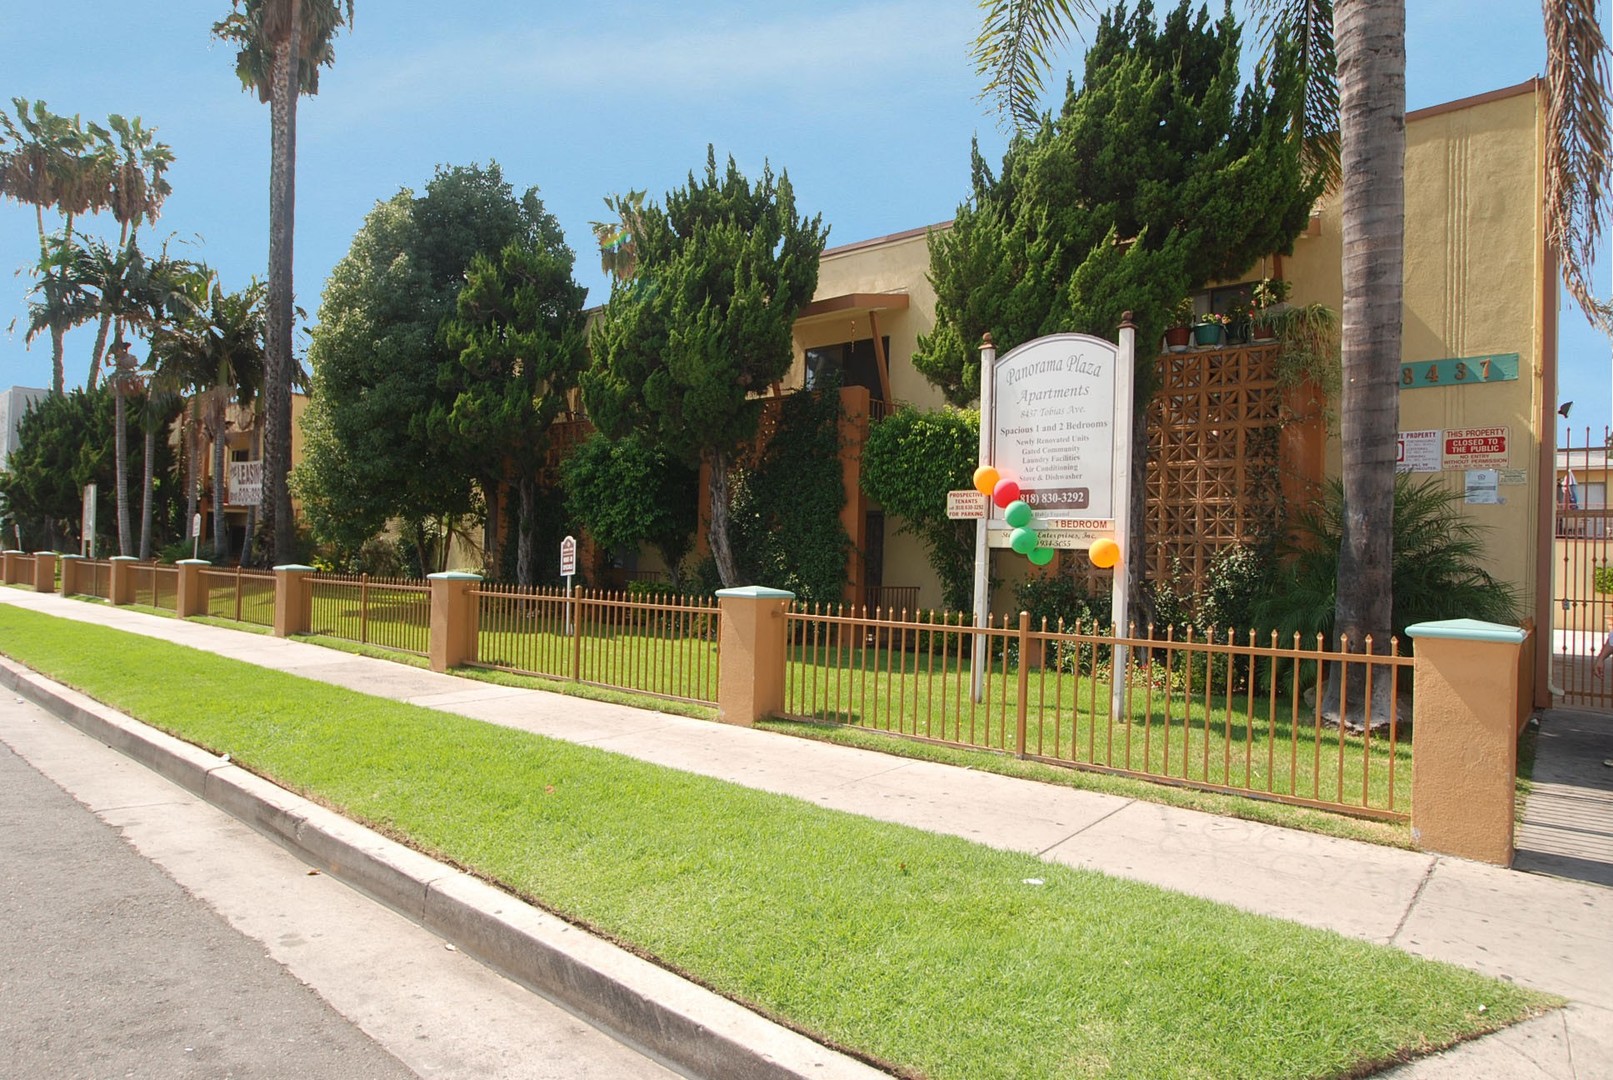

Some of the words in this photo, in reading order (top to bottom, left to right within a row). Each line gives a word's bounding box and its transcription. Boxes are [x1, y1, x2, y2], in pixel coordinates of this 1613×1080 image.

[1006, 359, 1063, 385] Panorama
[1065, 354, 1102, 377] Plaza
[1016, 385, 1090, 405] Apartments
[1040, 406, 1065, 417] Tobias
[1066, 405, 1086, 415] Ave.
[1000, 425, 1033, 436] Spacious
[1041, 423, 1057, 432] and
[1059, 422, 1064, 431] 2
[1066, 420, 1108, 430] Bedrooms
[1447, 430, 1463, 438] THIS
[1465, 428, 1505, 437] PROPERTY
[1406, 431, 1436, 439] PROPERTY
[1016, 438, 1035, 446] Newly
[1036, 436, 1070, 444] Renovated
[1453, 439, 1484, 447] CLOSED
[1022, 447, 1041, 455] Gated
[1042, 446, 1081, 454] Community
[1470, 445, 1500, 453] PUBLIC
[1022, 457, 1049, 465] Laundry
[1051, 454, 1081, 462] Facilities
[1036, 464, 1079, 472] Conditioning
[238, 463, 263, 485] LEASIN
[1019, 493, 1040, 505] 818)
[1041, 492, 1084, 503] 830-3292
[1060, 520, 1108, 528] BEDROOM
[1037, 531, 1080, 540] Enterprises,
[1082, 531, 1097, 539] Inc.
